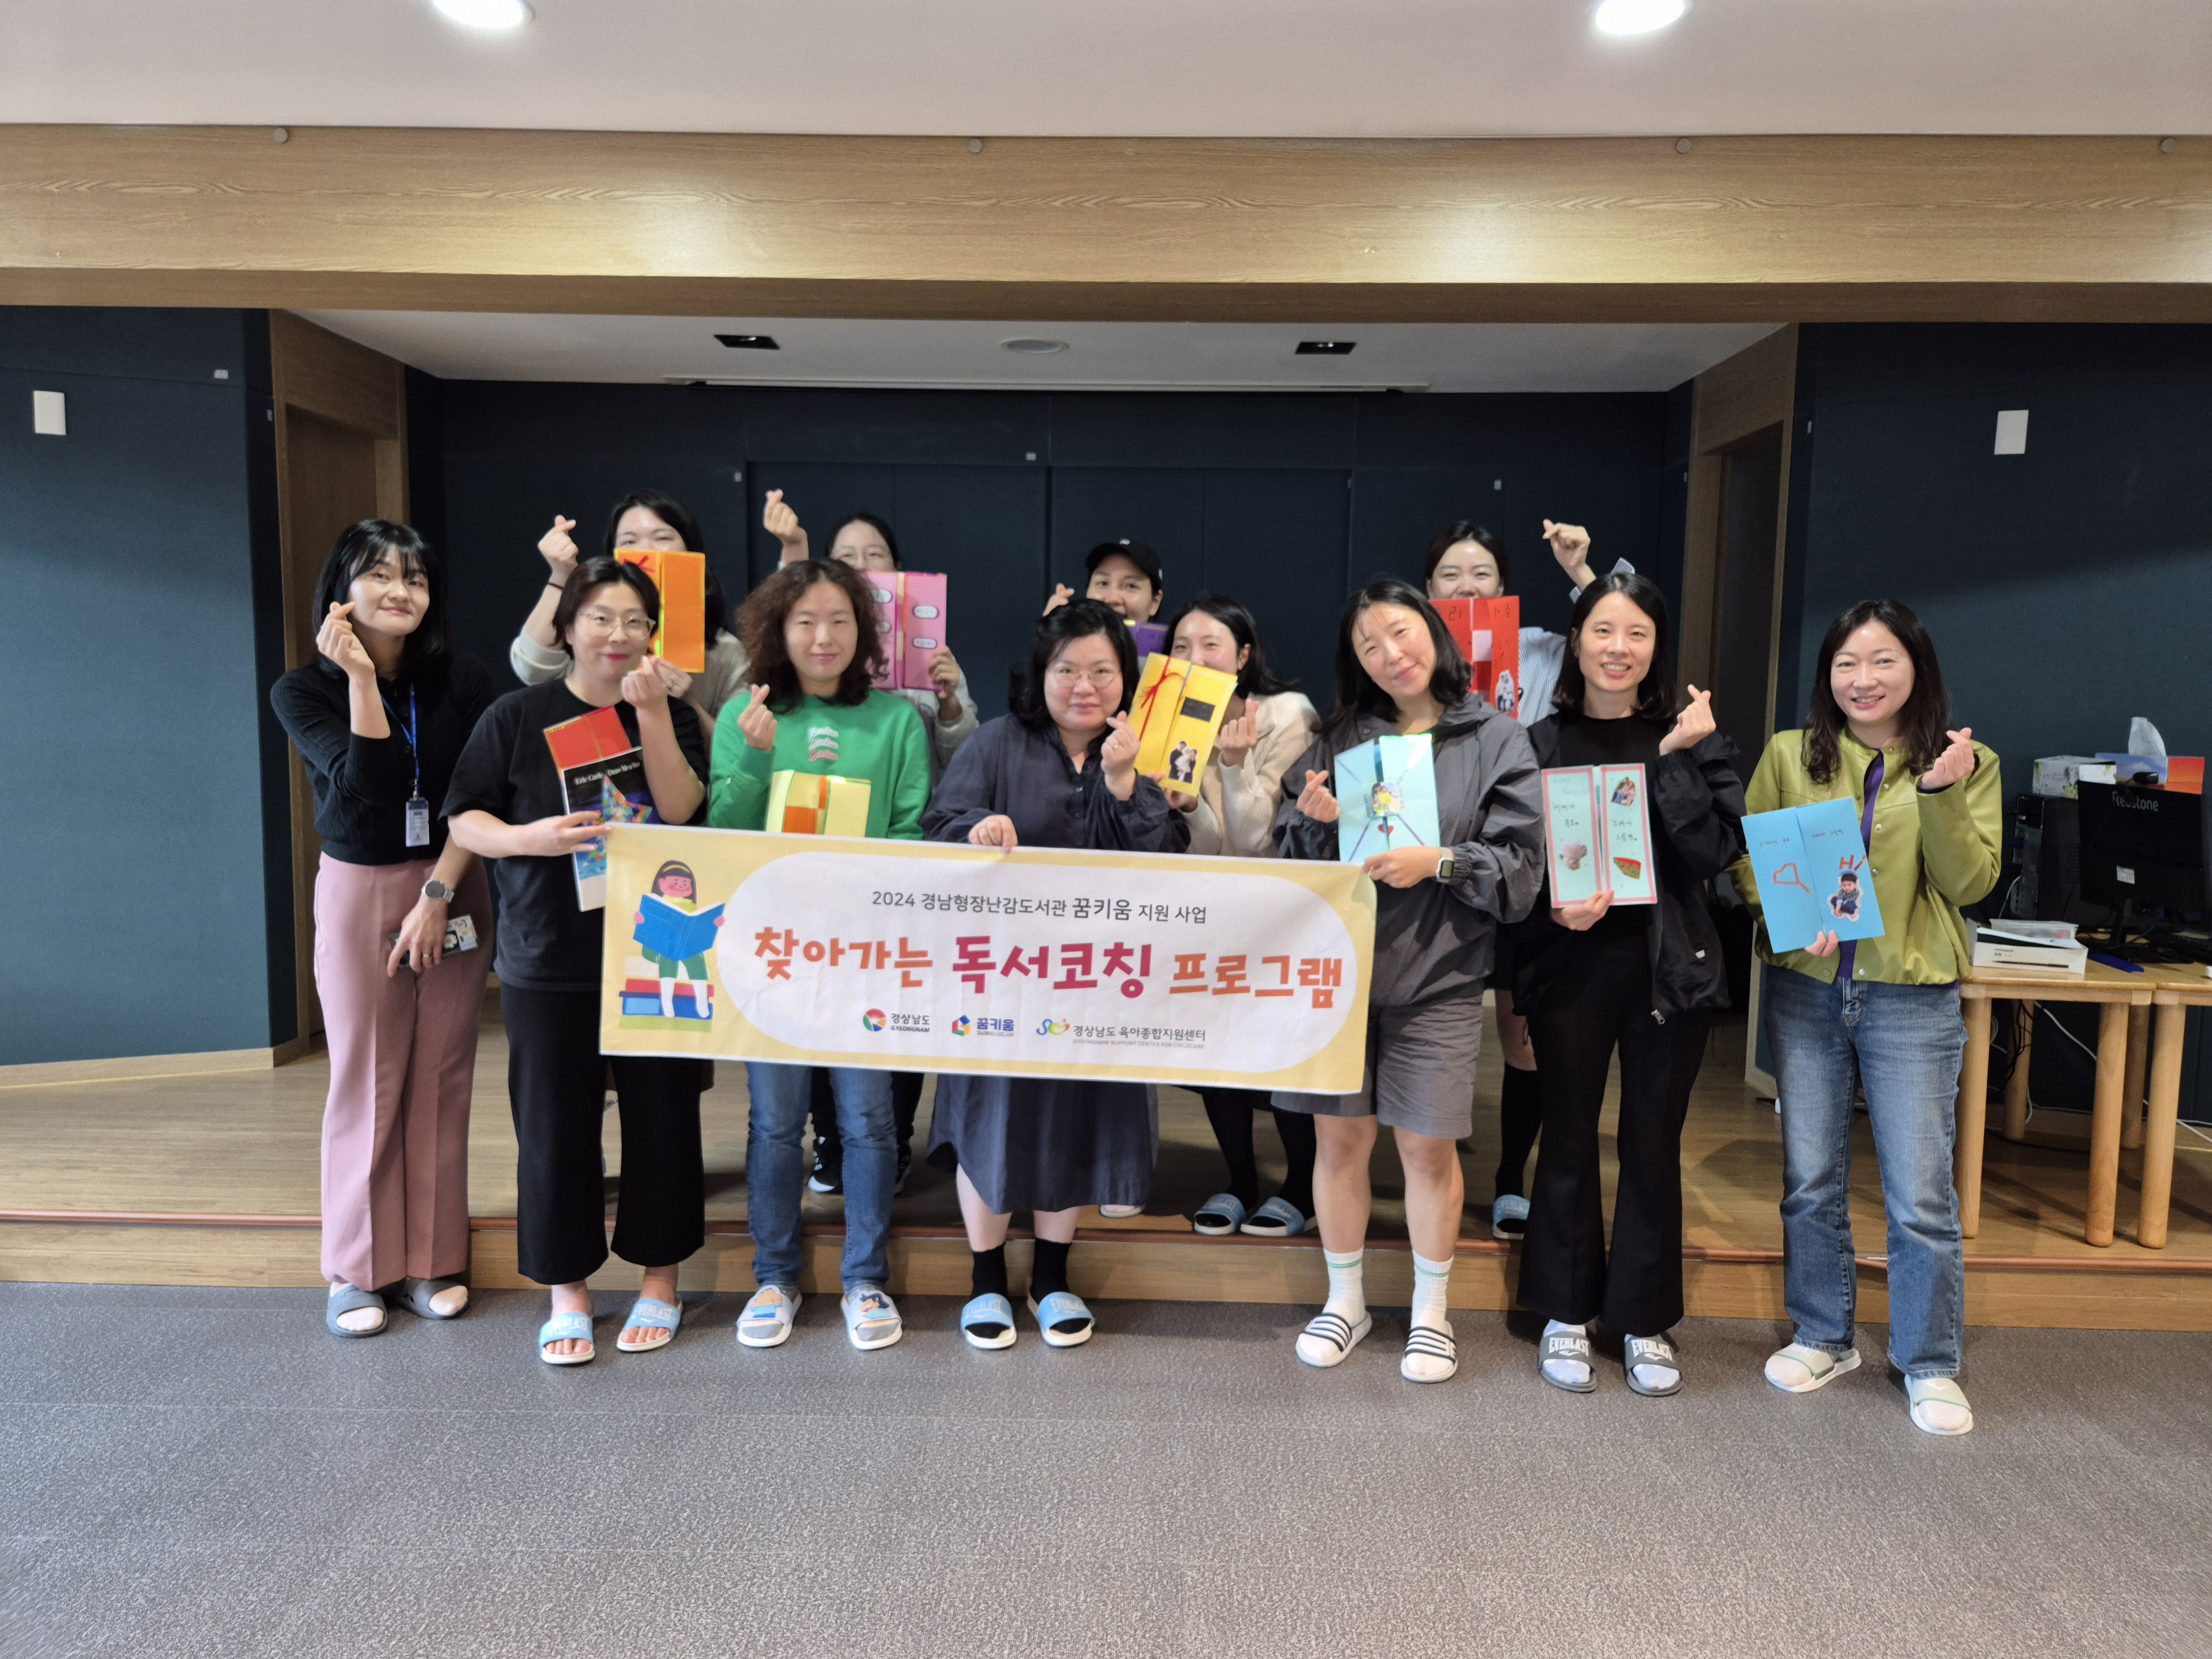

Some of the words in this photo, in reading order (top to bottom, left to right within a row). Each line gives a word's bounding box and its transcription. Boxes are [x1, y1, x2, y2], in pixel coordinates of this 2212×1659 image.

[575, 776, 587, 785] Eric
[1839, 854, 1867, 872] Hi
[872, 891, 916, 907] 2024
[921, 893, 1067, 917] 경남형장난감도서관
[1072, 898, 1133, 921] 꿈키움
[1138, 904, 1169, 922] 지원
[1175, 906, 1206, 924] 사업
[754, 926, 933, 988] 찾아가는
[952, 935, 1152, 999] 독서코칭
[1168, 953, 1342, 1009] 프로그램
[891, 1013, 930, 1025] 경상남도
[977, 1018, 1015, 1031] 꿈키움
[1073, 1025, 1116, 1037] 경상남도
[1119, 1026, 1206, 1042] 육아종합지원센터
[1549, 1337, 1589, 1357] EVERLAST
[1631, 1339, 1673, 1361] EVERLAST
